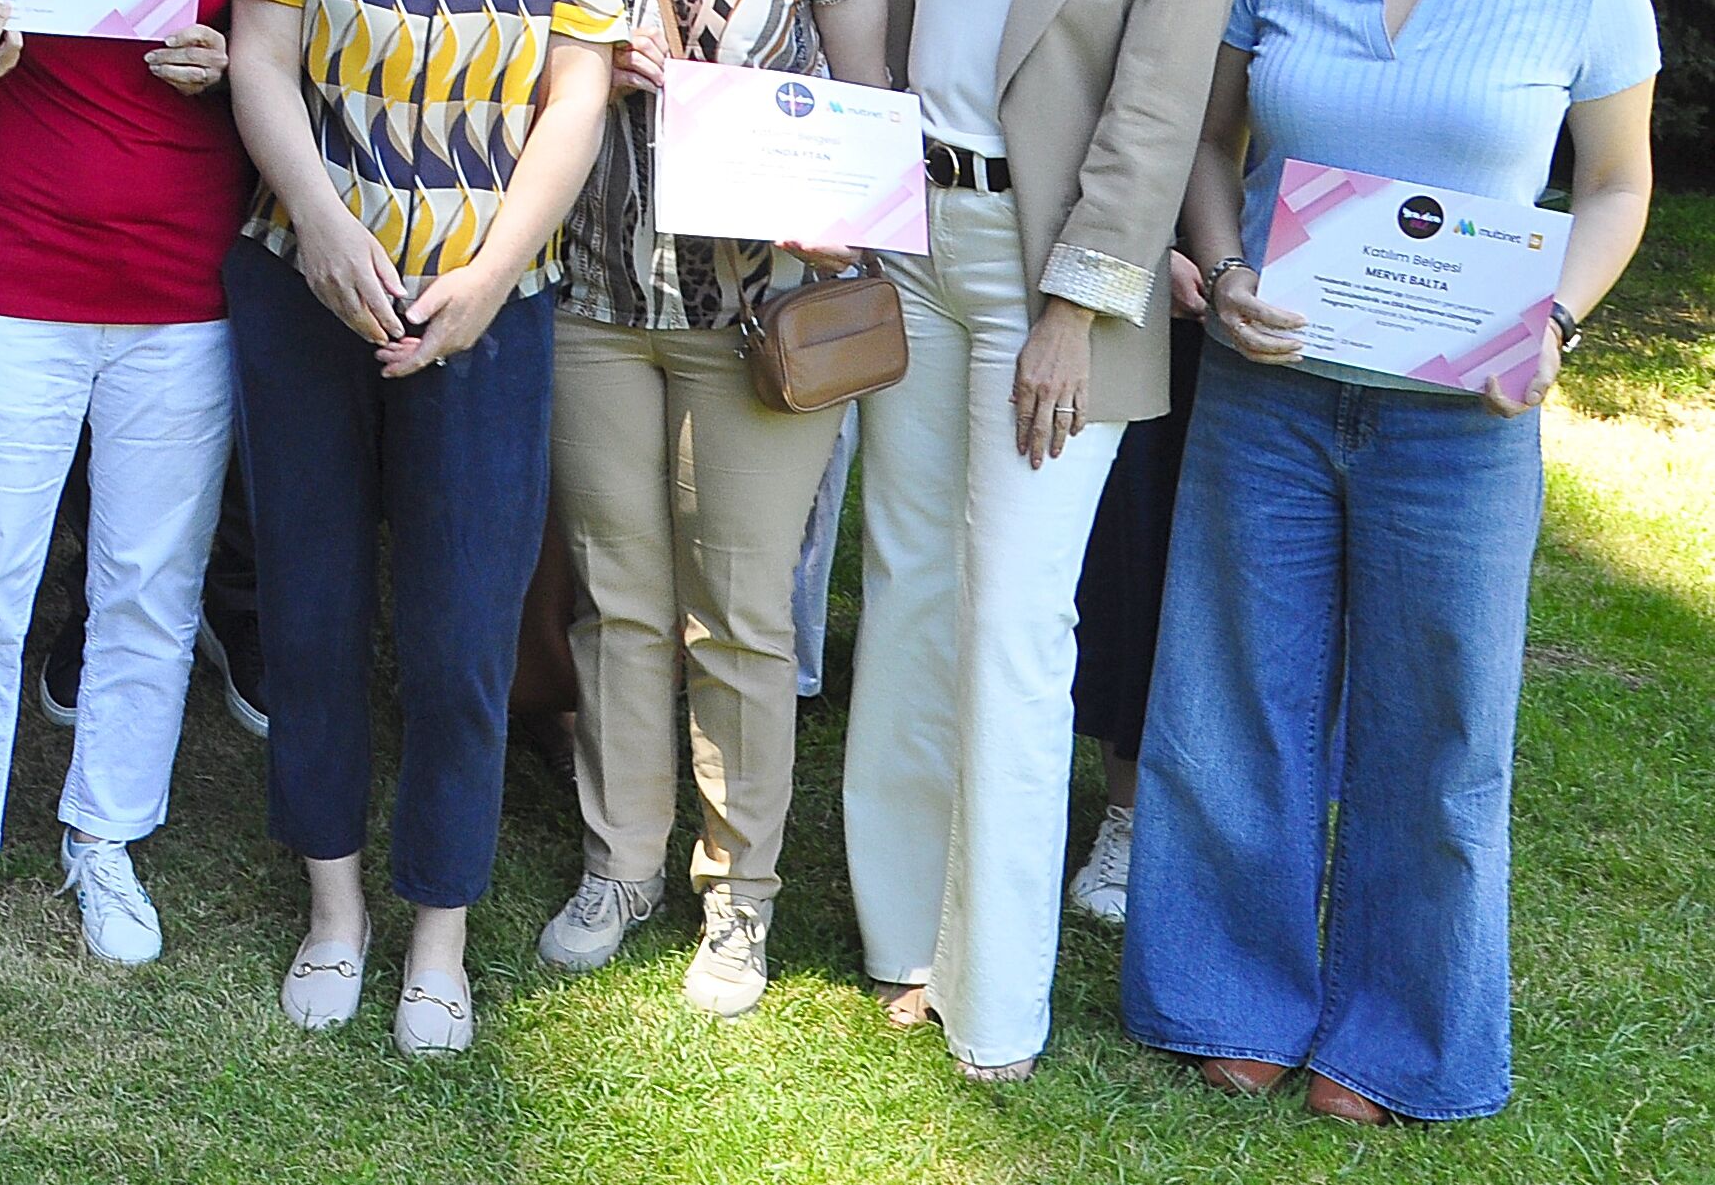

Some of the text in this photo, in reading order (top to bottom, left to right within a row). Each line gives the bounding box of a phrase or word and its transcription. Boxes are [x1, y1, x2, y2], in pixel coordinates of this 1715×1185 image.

[1413, 255, 1463, 273] Belgesi
[1365, 267, 1407, 284] MERVE
[1409, 275, 1448, 292] BALTA
